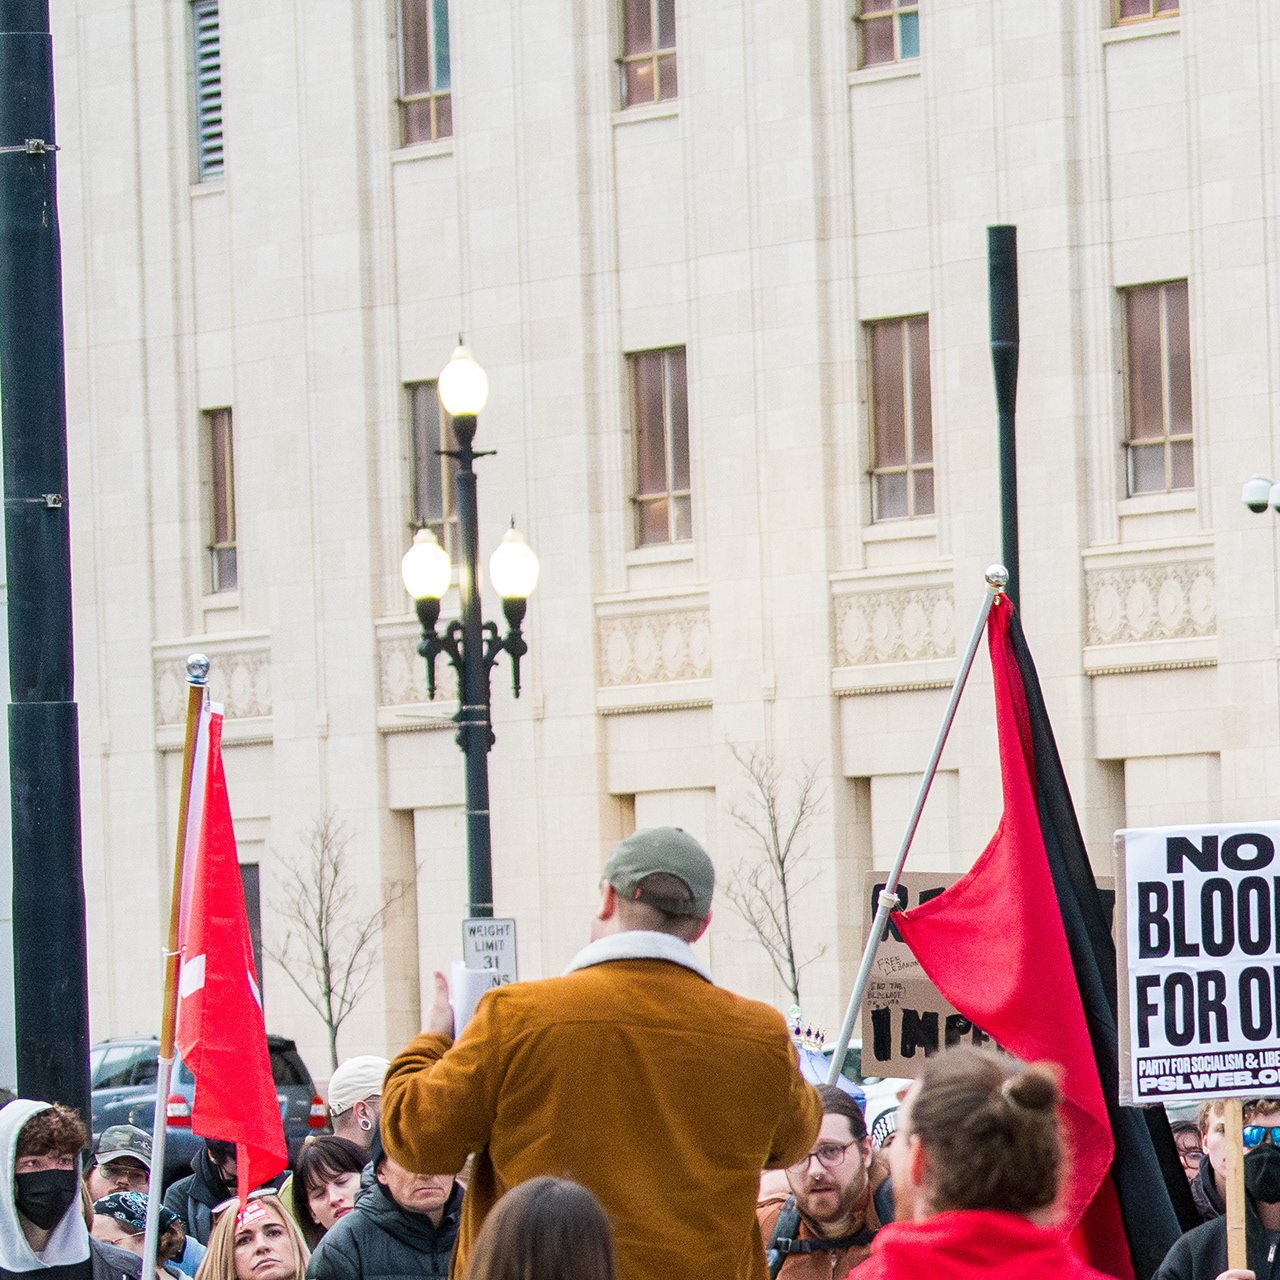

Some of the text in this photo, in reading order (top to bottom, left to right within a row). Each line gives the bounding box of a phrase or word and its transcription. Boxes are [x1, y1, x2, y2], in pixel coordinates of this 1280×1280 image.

[1166, 833, 1275, 874] NO
[468, 924, 510, 937] WEIGHT
[474, 940, 504, 952] LIMIT
[877, 956, 901, 970] FREE
[1135, 969, 1229, 1048] FOR
[1139, 1059, 1171, 1076] PARTY
[1171, 1058, 1191, 1074] FOR
[1191, 1053, 1243, 1073] SOCIALISM
[1245, 1052, 1259, 1068] &
